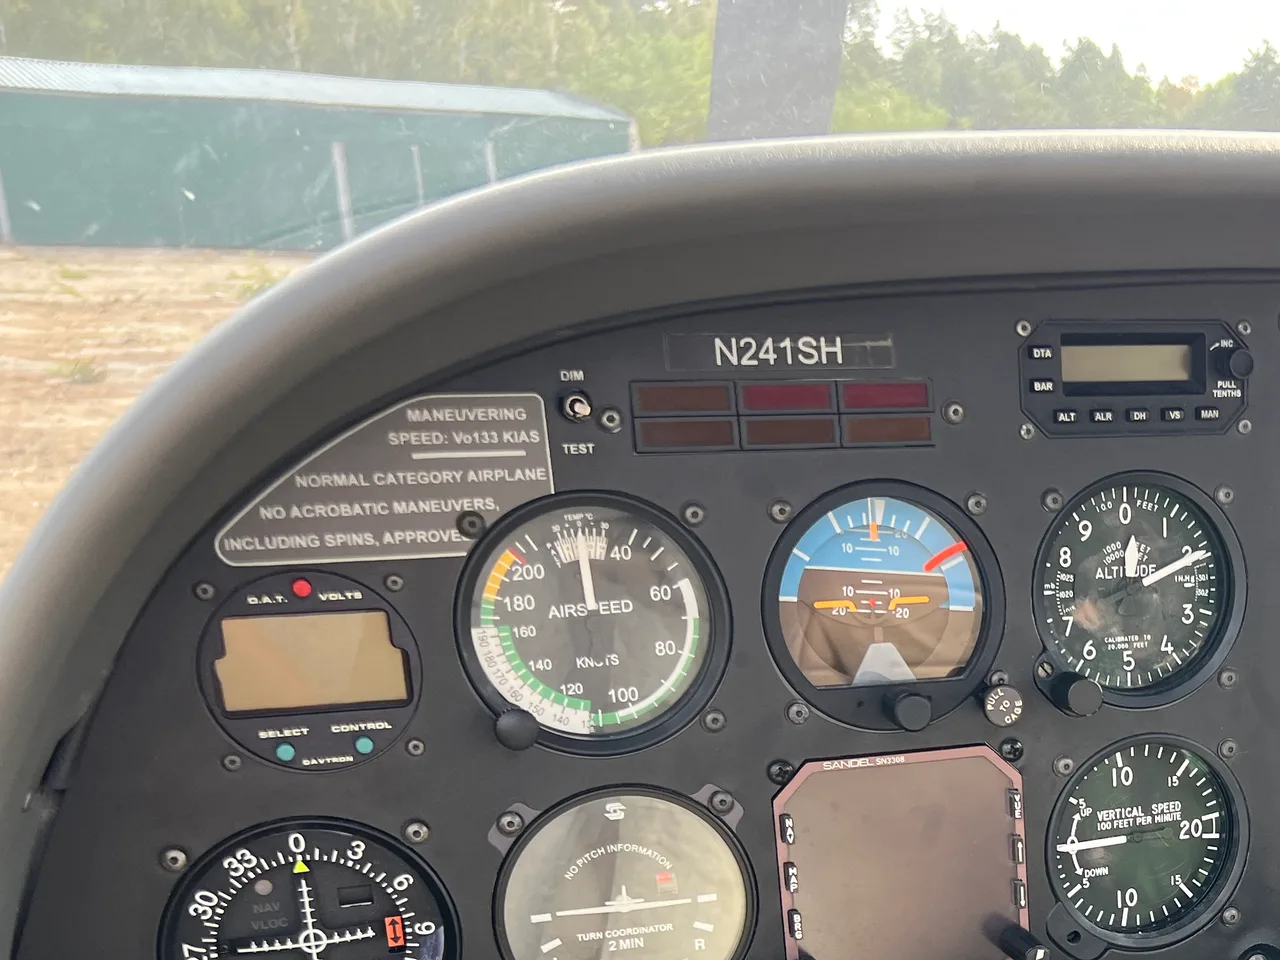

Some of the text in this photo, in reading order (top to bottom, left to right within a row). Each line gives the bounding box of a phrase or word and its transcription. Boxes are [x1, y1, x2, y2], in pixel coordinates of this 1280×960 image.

[714, 336, 843, 366] N241SH
[1220, 340, 1233, 348] INC
[1033, 348, 1052, 358] DTA
[560, 371, 584, 381] DIM
[1034, 382, 1053, 391] BAR
[1217, 381, 1236, 389] PULL
[1212, 389, 1241, 398] TENTHS
[407, 409, 527, 423] MANEUVERING
[1058, 412, 1076, 422] ALT
[1201, 409, 1219, 419] MAN
[389, 431, 540, 445] SPEED: Vo133 KIAS
[562, 443, 595, 455] TEST
[295, 469, 547, 488] NORMAL CATEGORY AIRPLANE
[261, 498, 500, 520] NO ACROBATIC MANEUVERS,
[224, 529, 470, 551] INCLUDING SPINS, APPROVE
[610, 545, 632, 561] 40
[512, 564, 545, 581] 200
[318, 590, 363, 601] VOLTS
[649, 585, 672, 601] 60
[548, 600, 634, 619] AIRSEED
[655, 640, 676, 656] 80
[608, 687, 639, 704] 100
[258, 727, 310, 739] SELECT
[331, 722, 392, 734] CONTROL
[302, 755, 354, 766] DAVTRON
[823, 755, 905, 771] SANDEL SN3308
[1097, 800, 1182, 822] VERTICAL SPEED
[1097, 811, 1182, 831] 100 FEET PER MINUTE
[1179, 818, 1203, 840] 20
[288, 832, 306, 853] 0
[347, 840, 366, 860] 3
[564, 843, 673, 881] NO PITCH INFORMATION
[1084, 867, 1109, 878] DOWN
[576, 923, 674, 942] TURN COORDINATOR
[608, 937, 644, 952] 2 MIN
